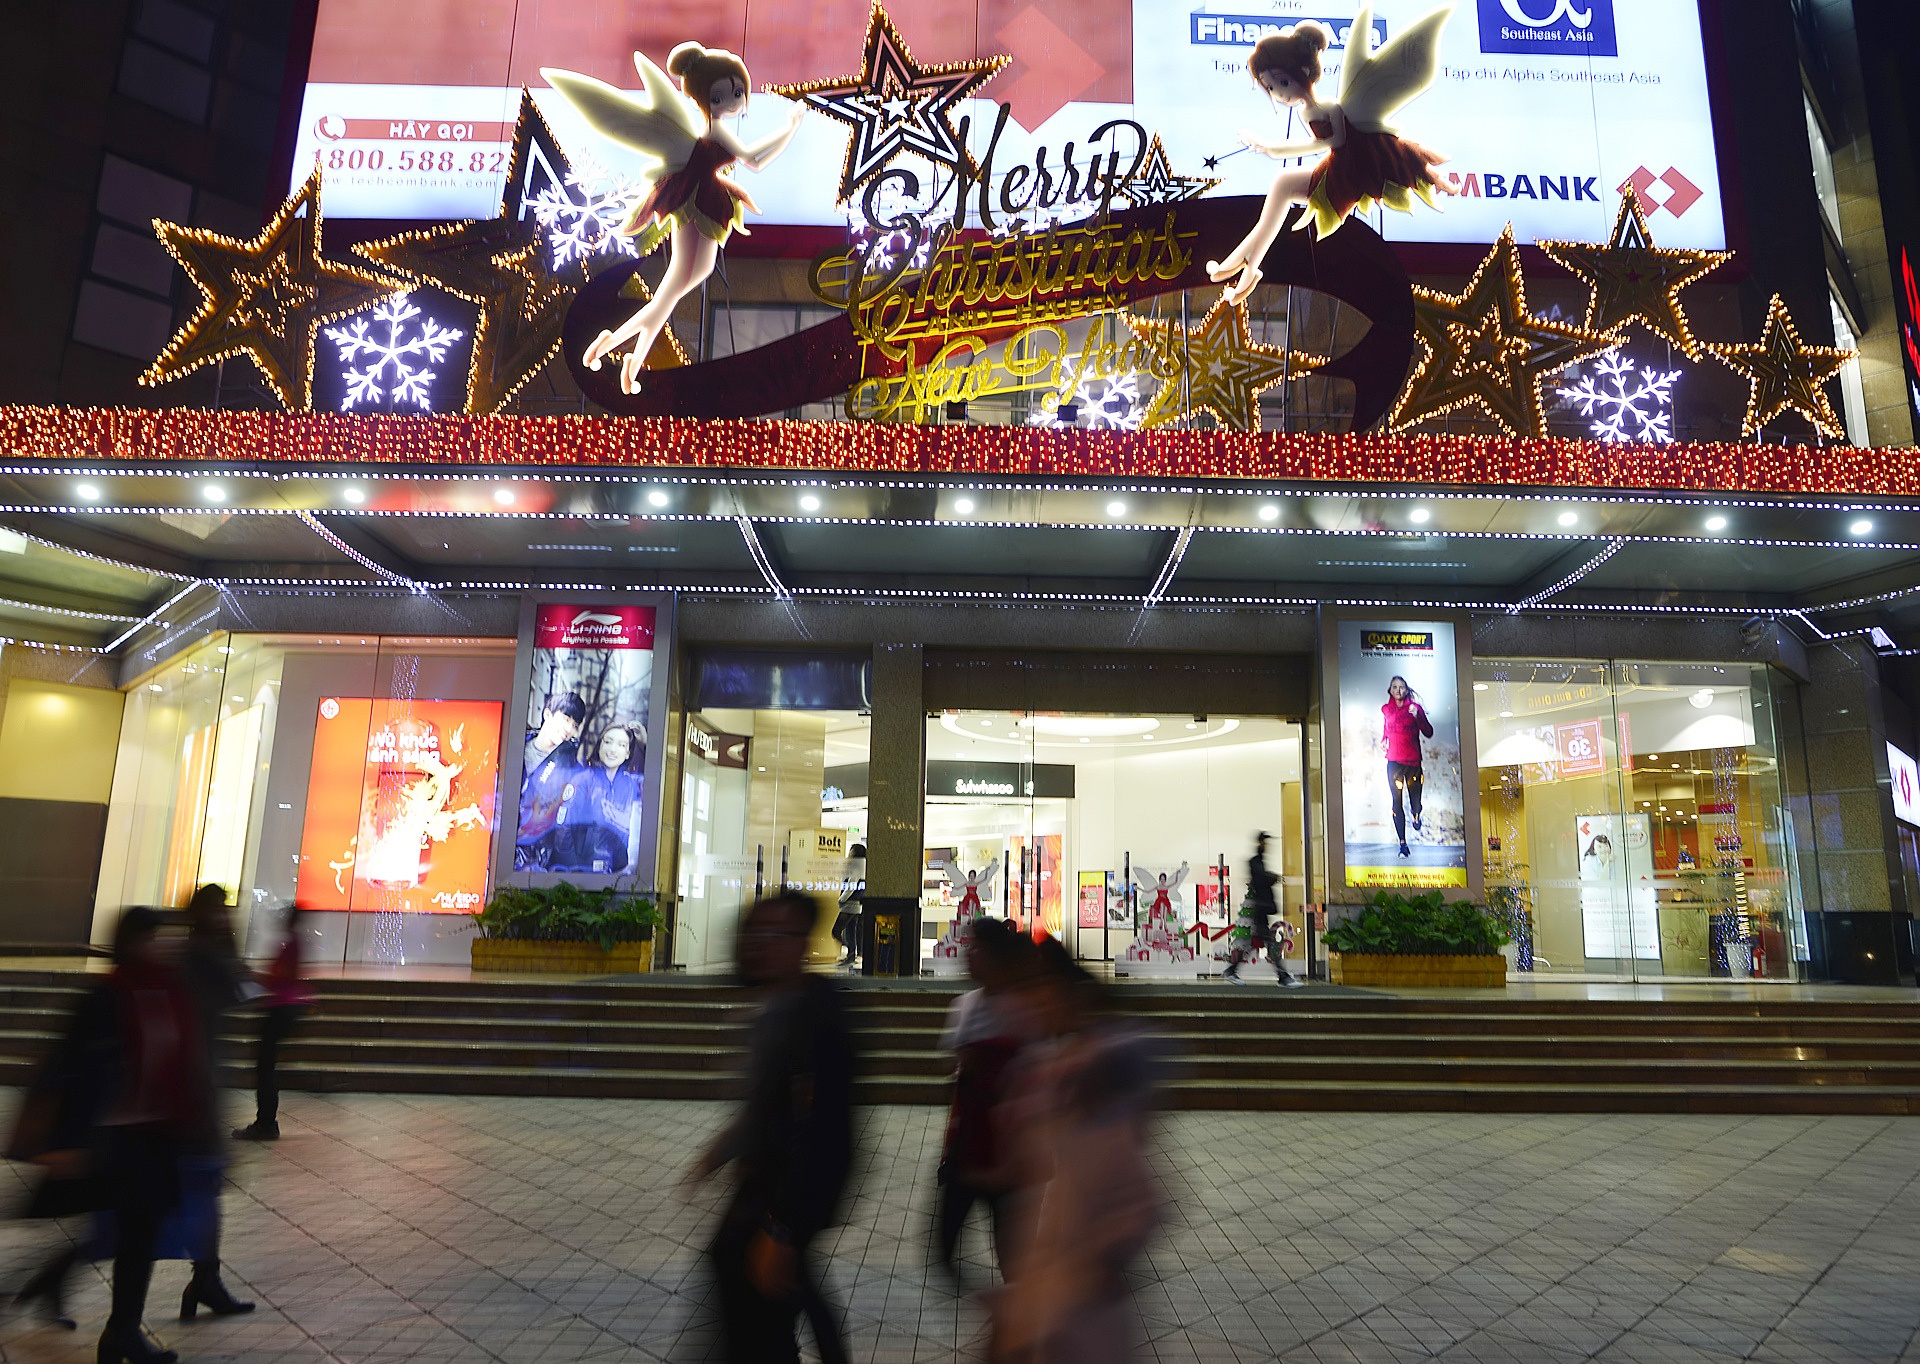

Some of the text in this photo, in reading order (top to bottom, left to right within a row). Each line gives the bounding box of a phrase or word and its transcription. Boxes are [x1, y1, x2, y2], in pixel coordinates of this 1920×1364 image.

[1501, 27, 1594, 42] Southeast Asia
[1502, 68, 1545, 84] Alpha
[1549, 69, 1625, 85] Southeast
[1629, 72, 1662, 85] Asia
[388, 119, 431, 139] HÃY
[862, 102, 1147, 236] Merry
[808, 208, 1193, 361] Christmas
[926, 291, 1129, 333] AND HAPPY
[844, 335, 1001, 425] New
[570, 625, 622, 635] LI-NING
[1400, 634, 1427, 645] SPORT
[955, 778, 1014, 795] Sulwhasoo
